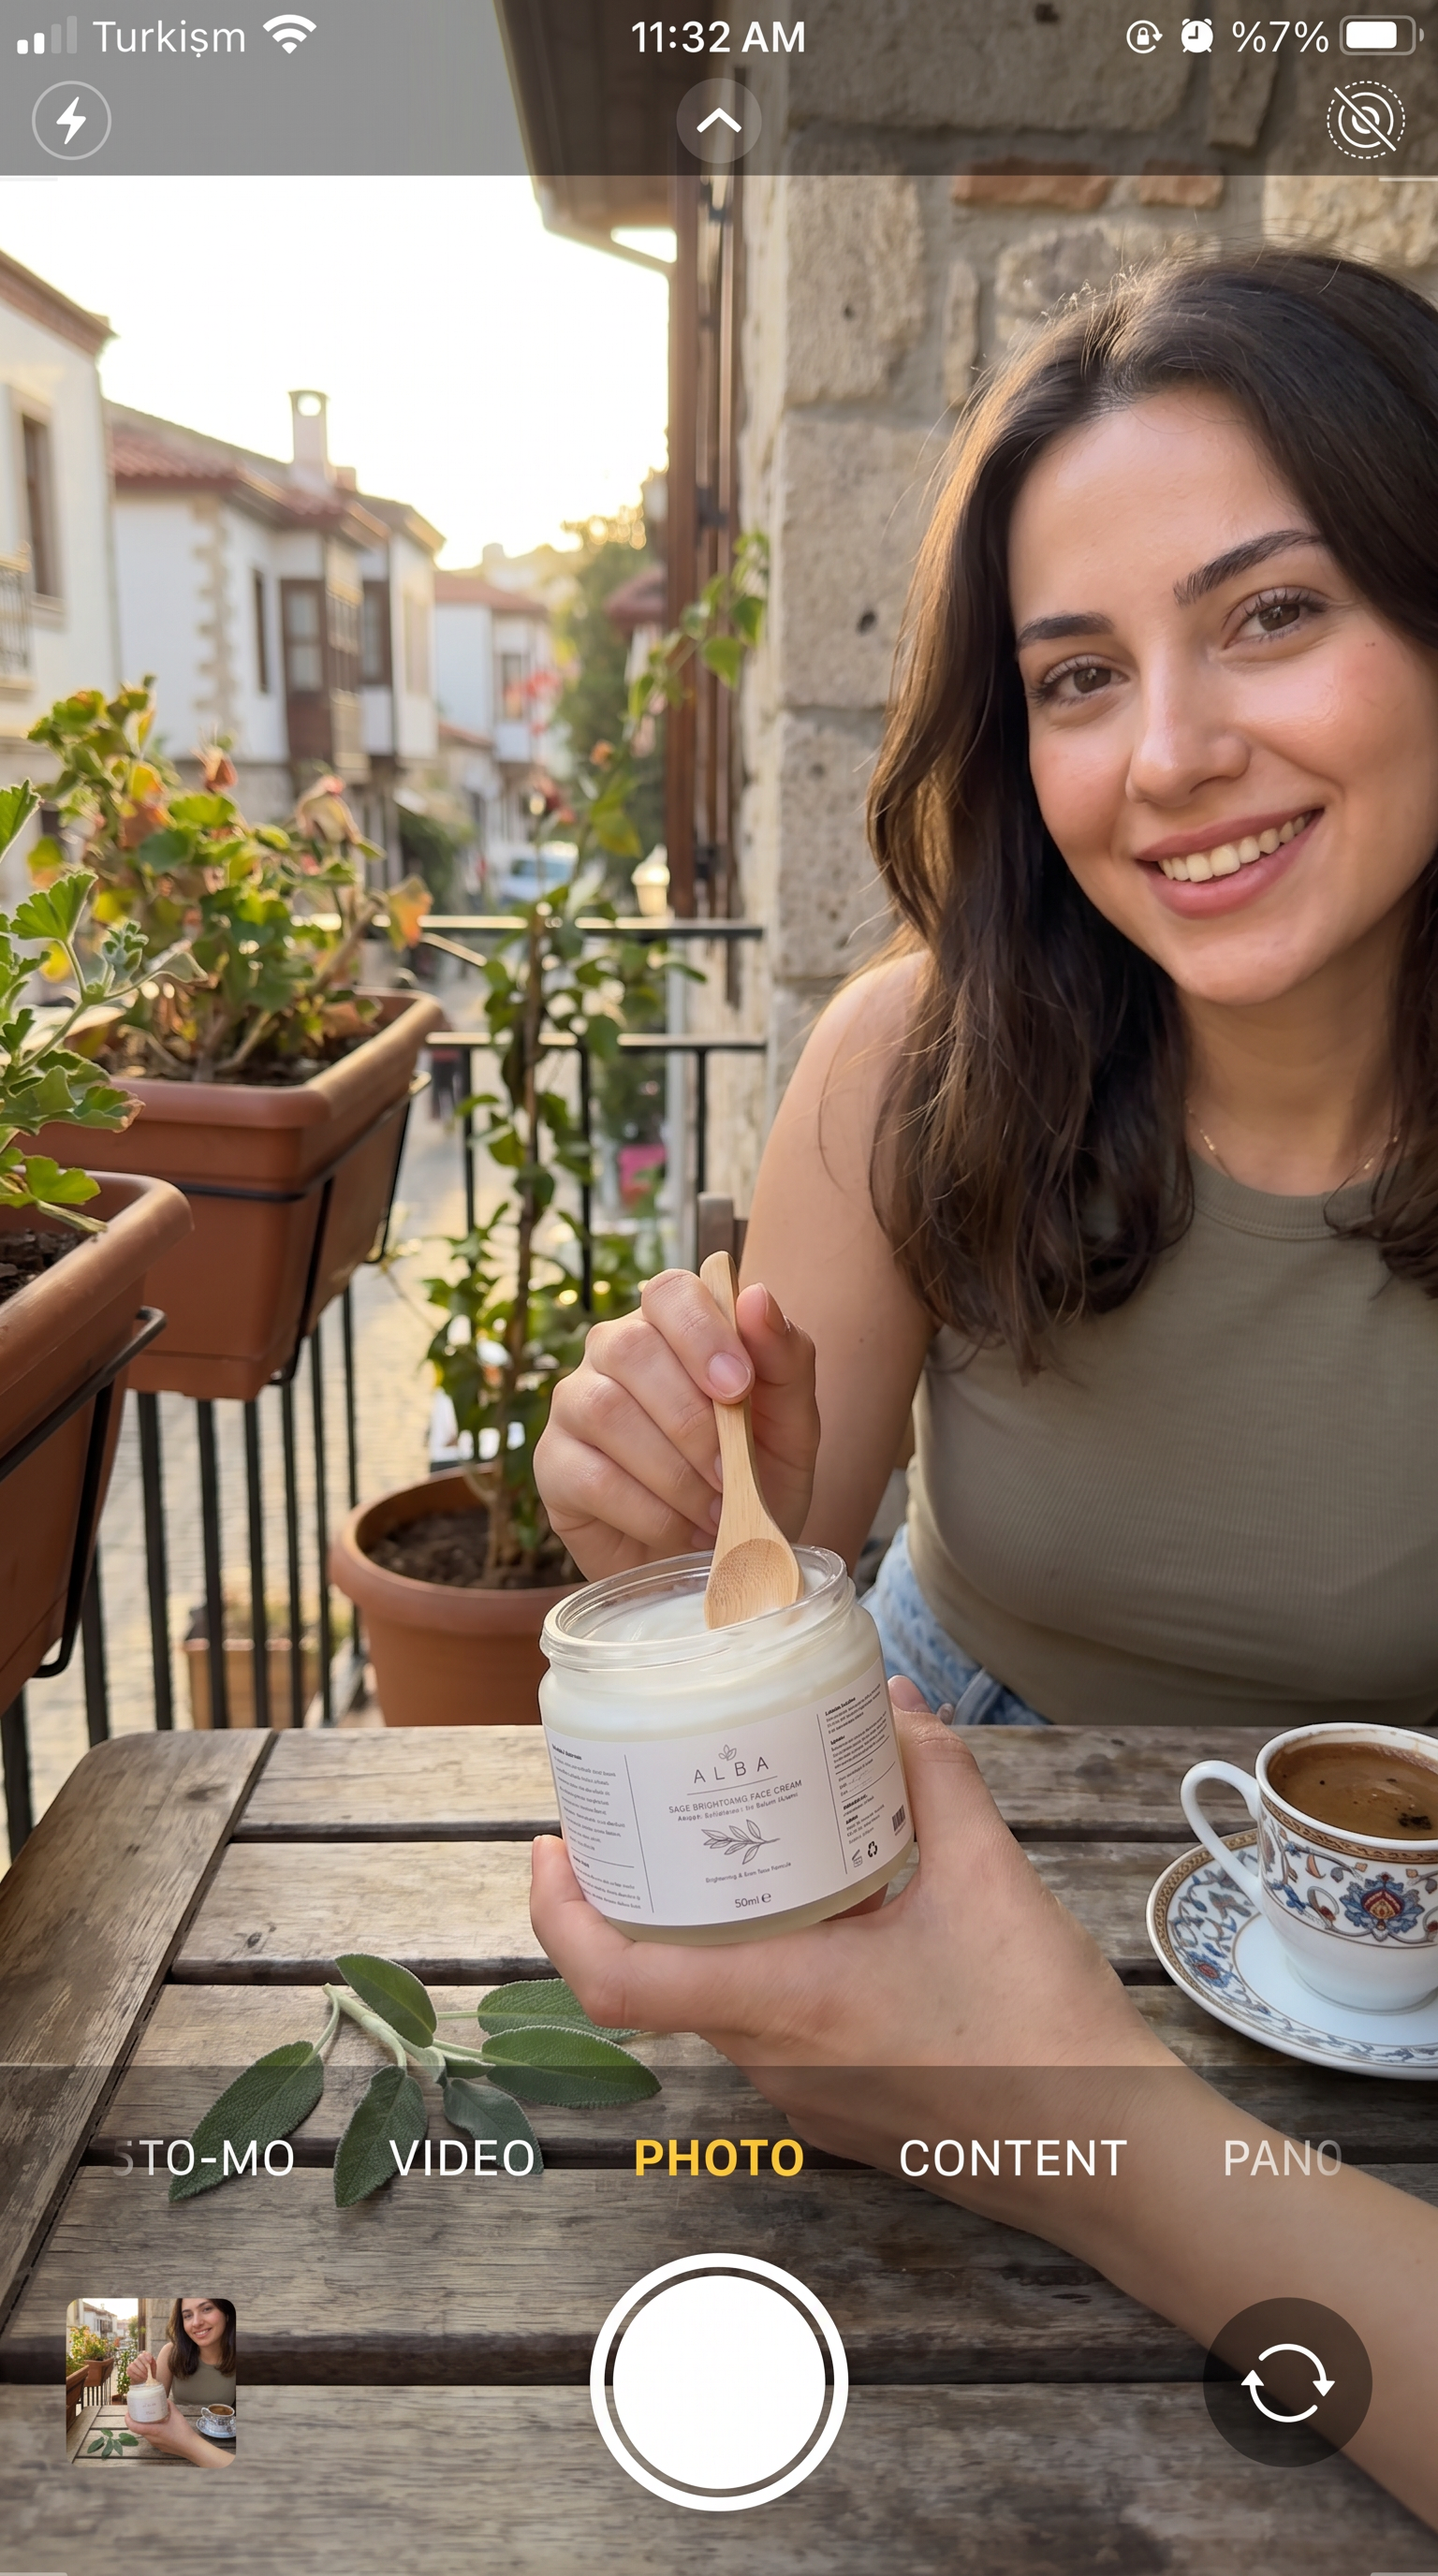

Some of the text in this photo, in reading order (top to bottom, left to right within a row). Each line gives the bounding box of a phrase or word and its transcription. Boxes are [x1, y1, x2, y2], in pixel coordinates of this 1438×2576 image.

[694, 1756, 769, 1784] ALBA
[668, 1805, 691, 1813] SAGE
[750, 1789, 771, 1801] FACE
[773, 1779, 802, 1794] CREAM
[735, 1895, 760, 1909] 50ml
